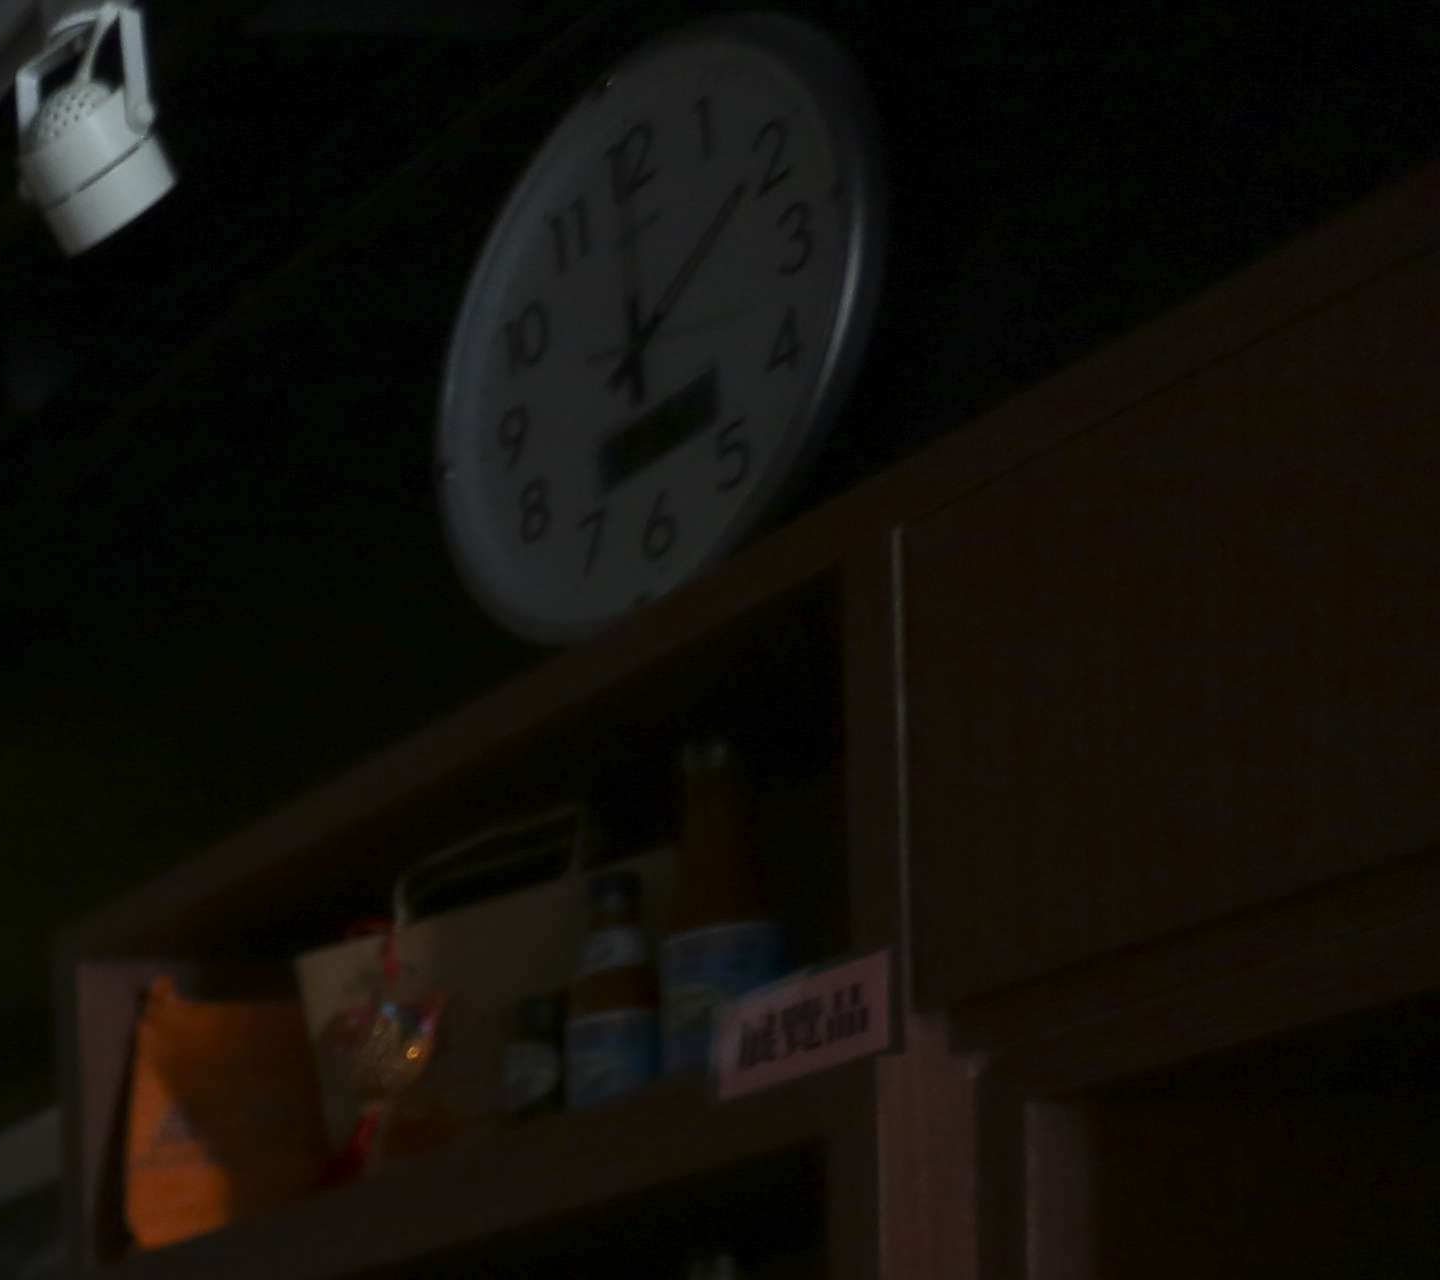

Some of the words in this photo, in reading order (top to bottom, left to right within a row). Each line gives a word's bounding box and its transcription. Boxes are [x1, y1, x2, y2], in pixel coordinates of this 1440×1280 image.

[606, 122, 659, 204] 12
[692, 95, 714, 160] 1
[751, 119, 796, 198] 2
[542, 197, 591, 275] 11
[777, 200, 814, 277] 3
[502, 302, 548, 379] 10
[766, 306, 801, 374] 4
[497, 405, 529, 470] 9
[717, 416, 750, 492] 5
[520, 477, 549, 543] 8
[577, 509, 605, 579] 7
[642, 492, 675, 561] 6
